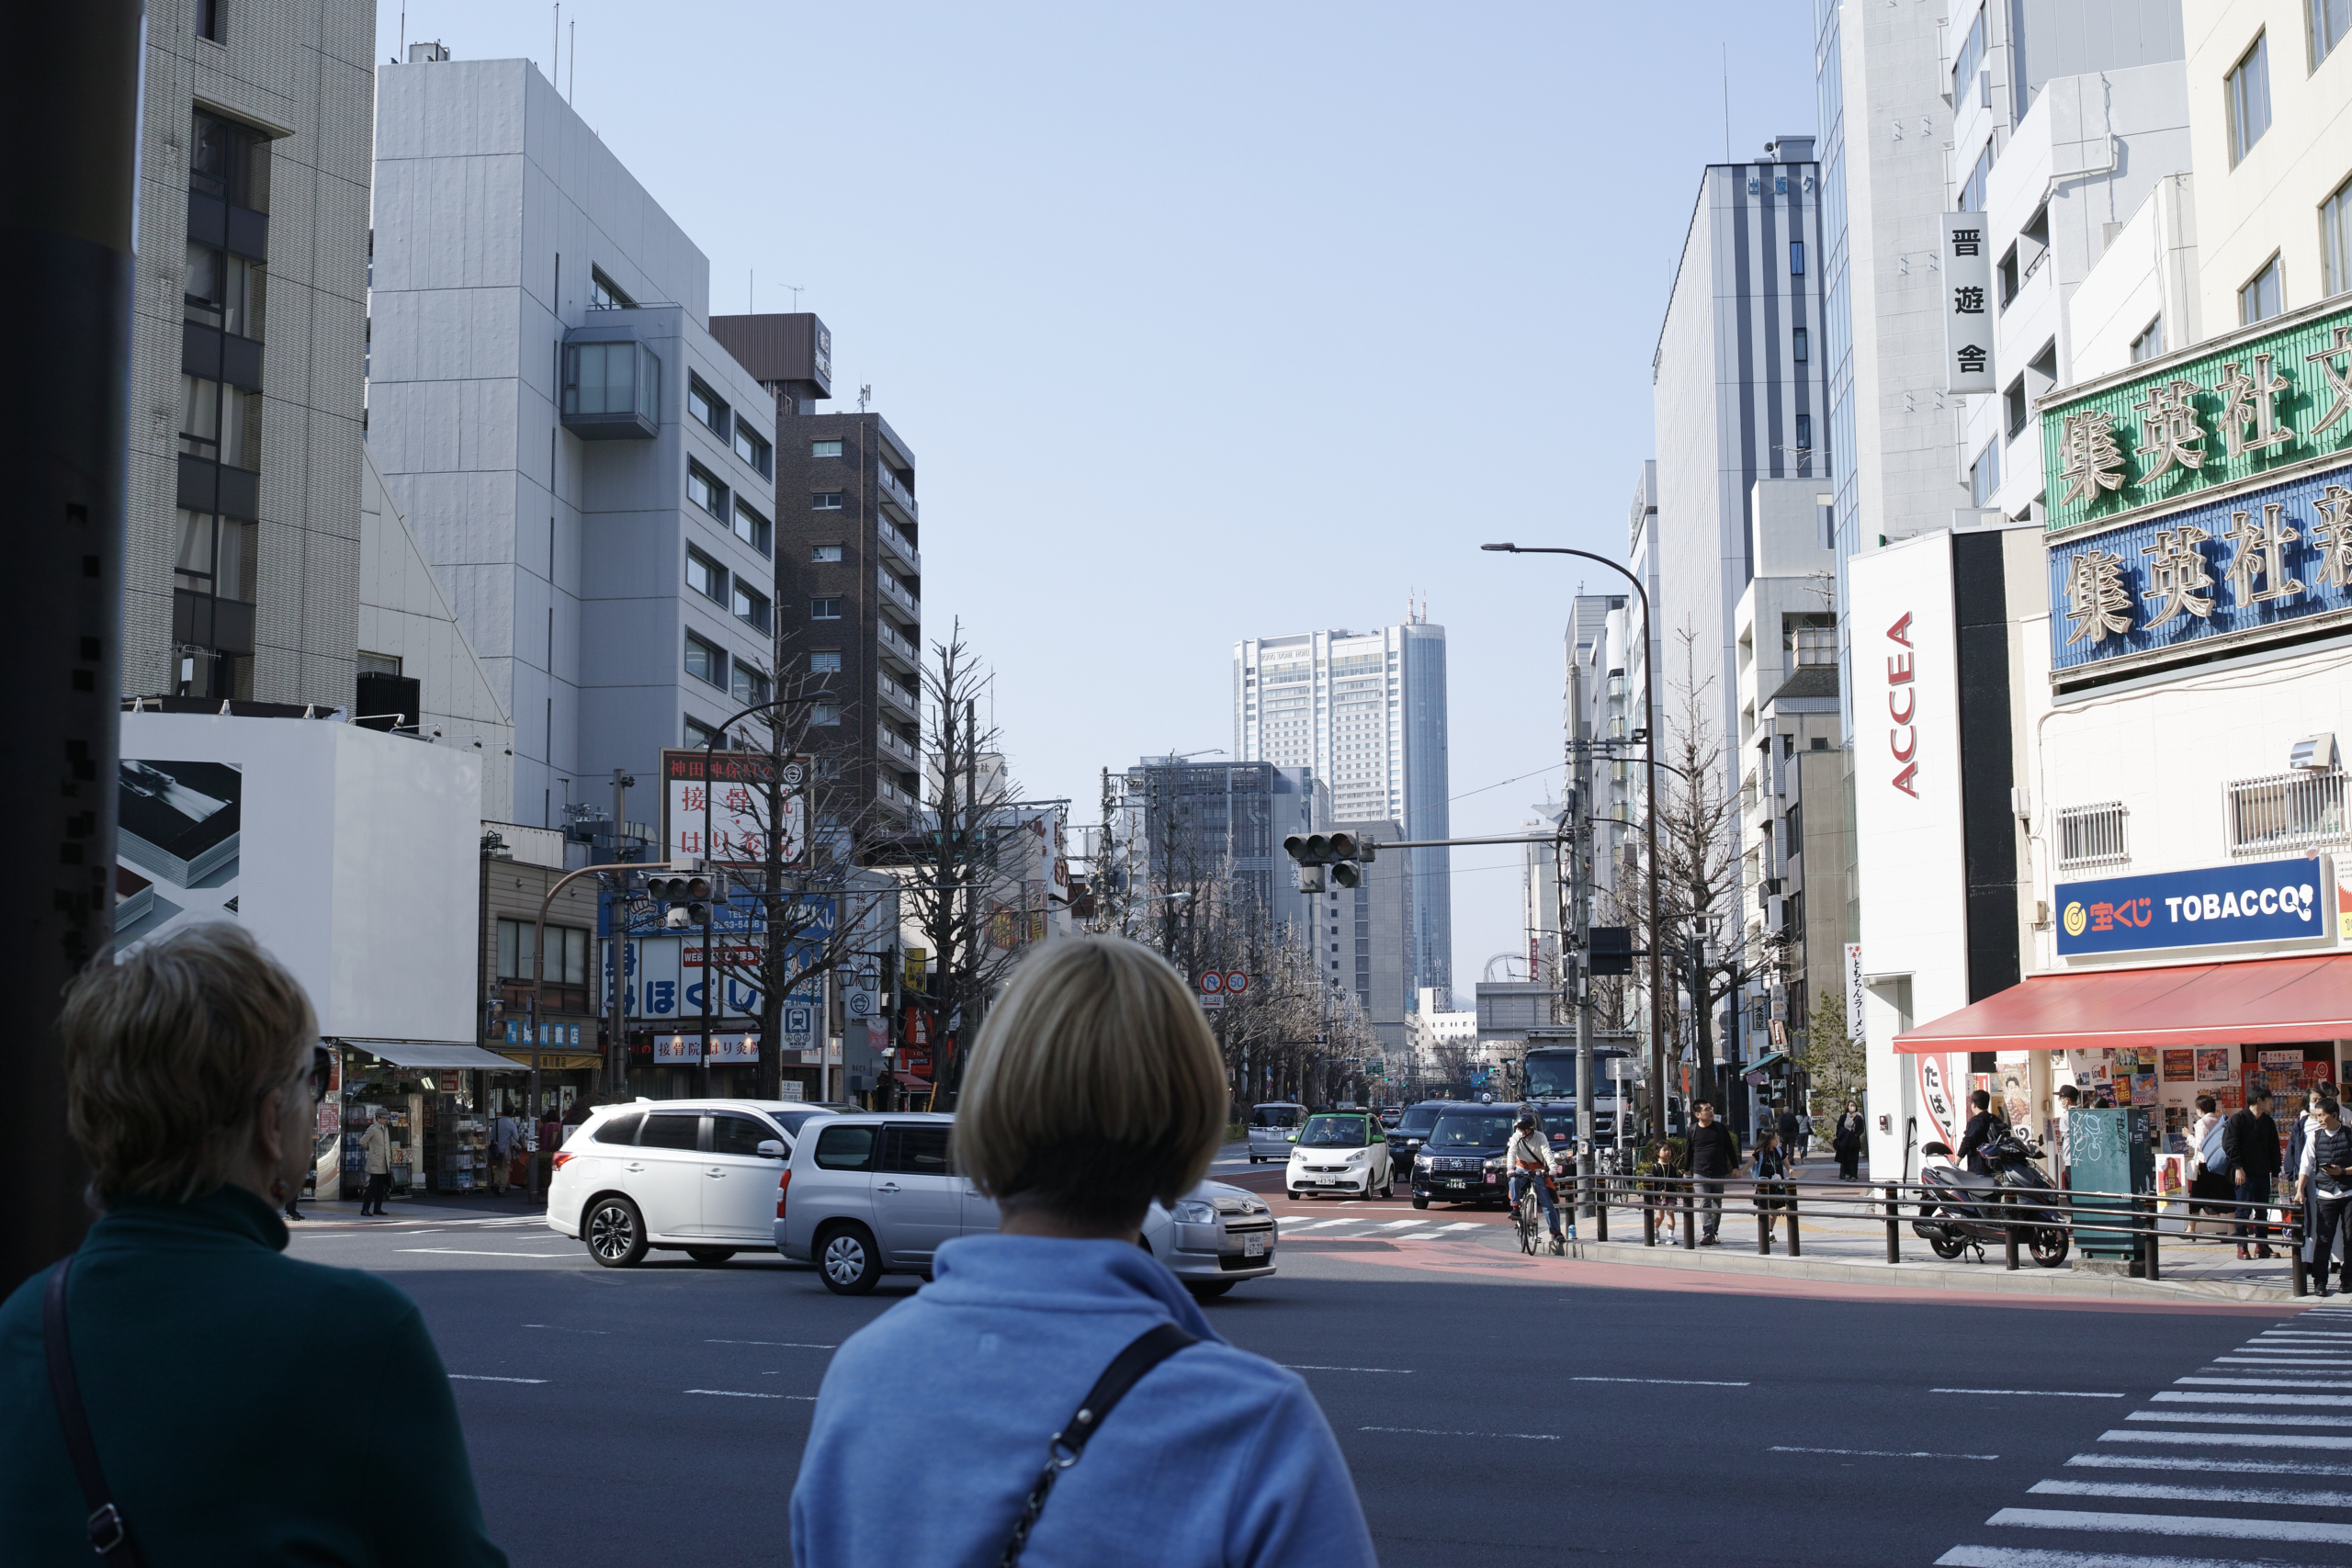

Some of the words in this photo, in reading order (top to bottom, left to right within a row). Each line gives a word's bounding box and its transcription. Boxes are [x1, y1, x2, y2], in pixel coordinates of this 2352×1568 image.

[1747, 175, 1815, 195] 出版ク
[1951, 229, 1987, 373] 晋遊舎
[1295, 649, 1310, 658] HOTEL
[1886, 610, 1919, 800] ACCEA
[2090, 902, 2153, 931] 宝くじ
[2165, 886, 2299, 923] TOBACCO
[1230, 976, 1244, 987] 50
[1853, 959, 1864, 1037] ともちんラーメン
[1925, 1066, 1951, 1138] たばこ
